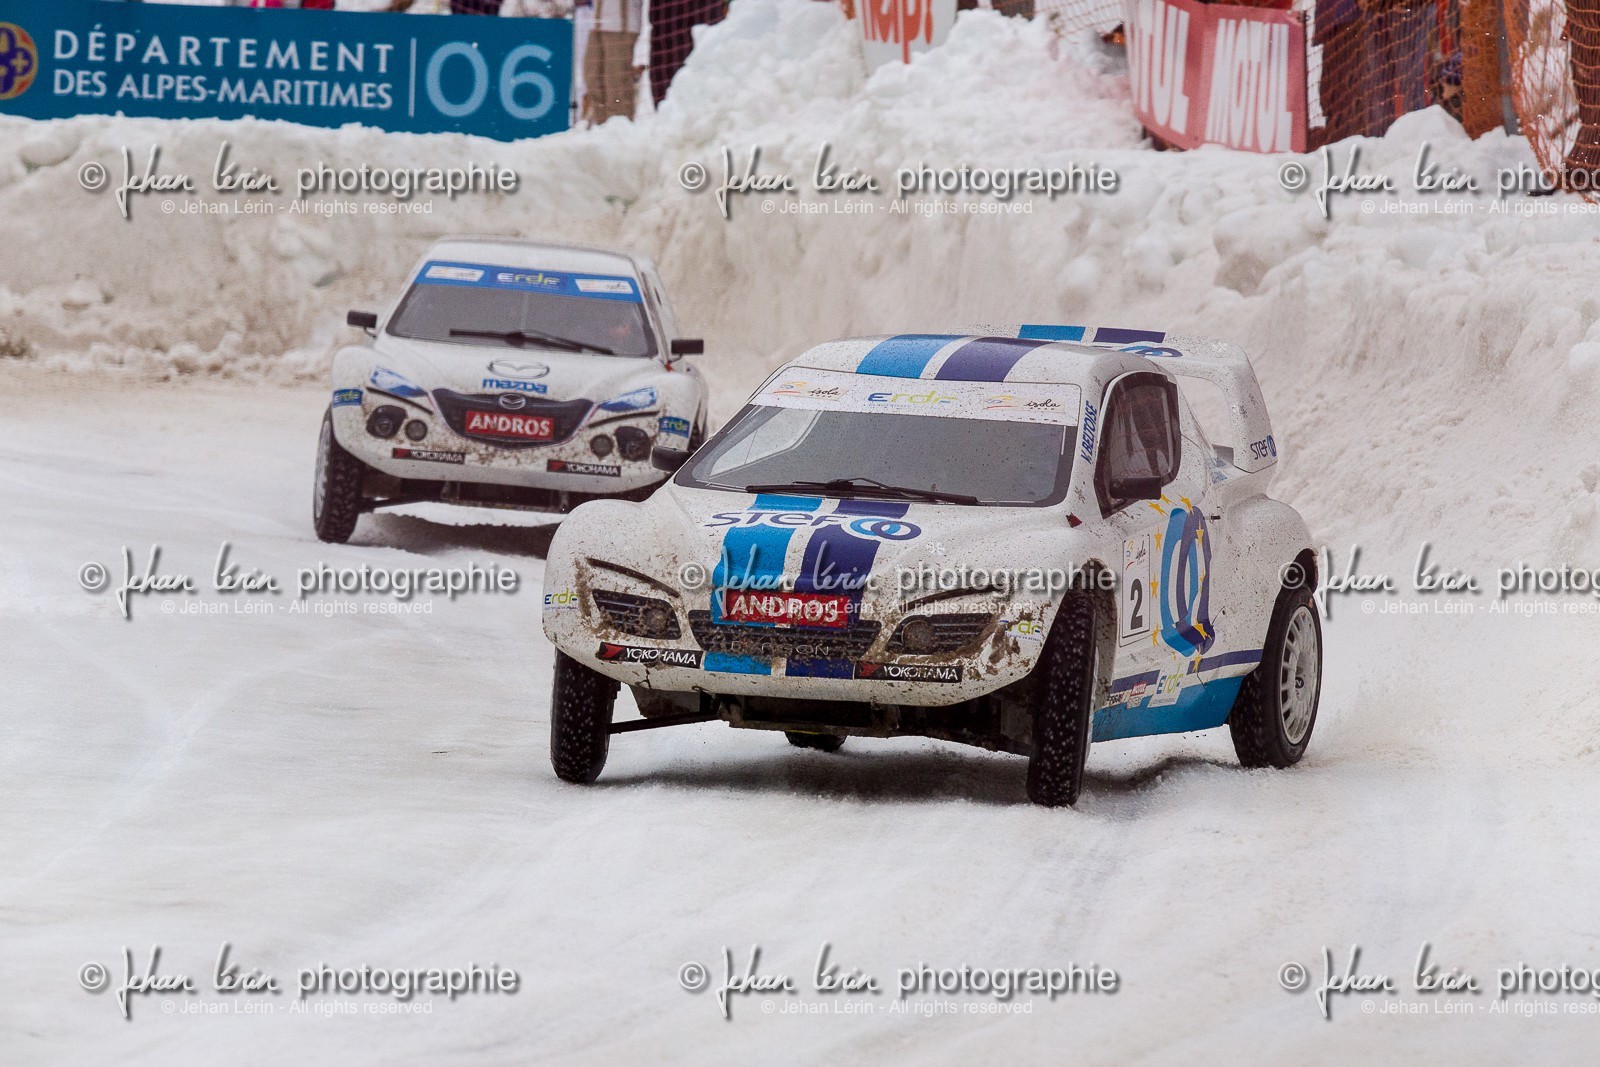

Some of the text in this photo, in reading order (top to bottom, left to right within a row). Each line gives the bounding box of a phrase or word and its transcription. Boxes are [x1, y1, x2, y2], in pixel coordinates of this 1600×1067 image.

[53, 24, 394, 74] DÉPARTEMENT
[53, 69, 394, 109] DES ALPES-MARITIMES
[425, 41, 555, 120] 06
[1205, 18, 1293, 152] MOTUL
[469, 413, 550, 436] ANDROS
[410, 449, 464, 463] YOKOHAMA
[566, 463, 619, 475] YOKOHAMA
[730, 594, 839, 623] ANDROS
[1130, 579, 1143, 630] 2
[625, 647, 697, 665] YOKOHAMA
[883, 664, 959, 681] YOKOHAMA
